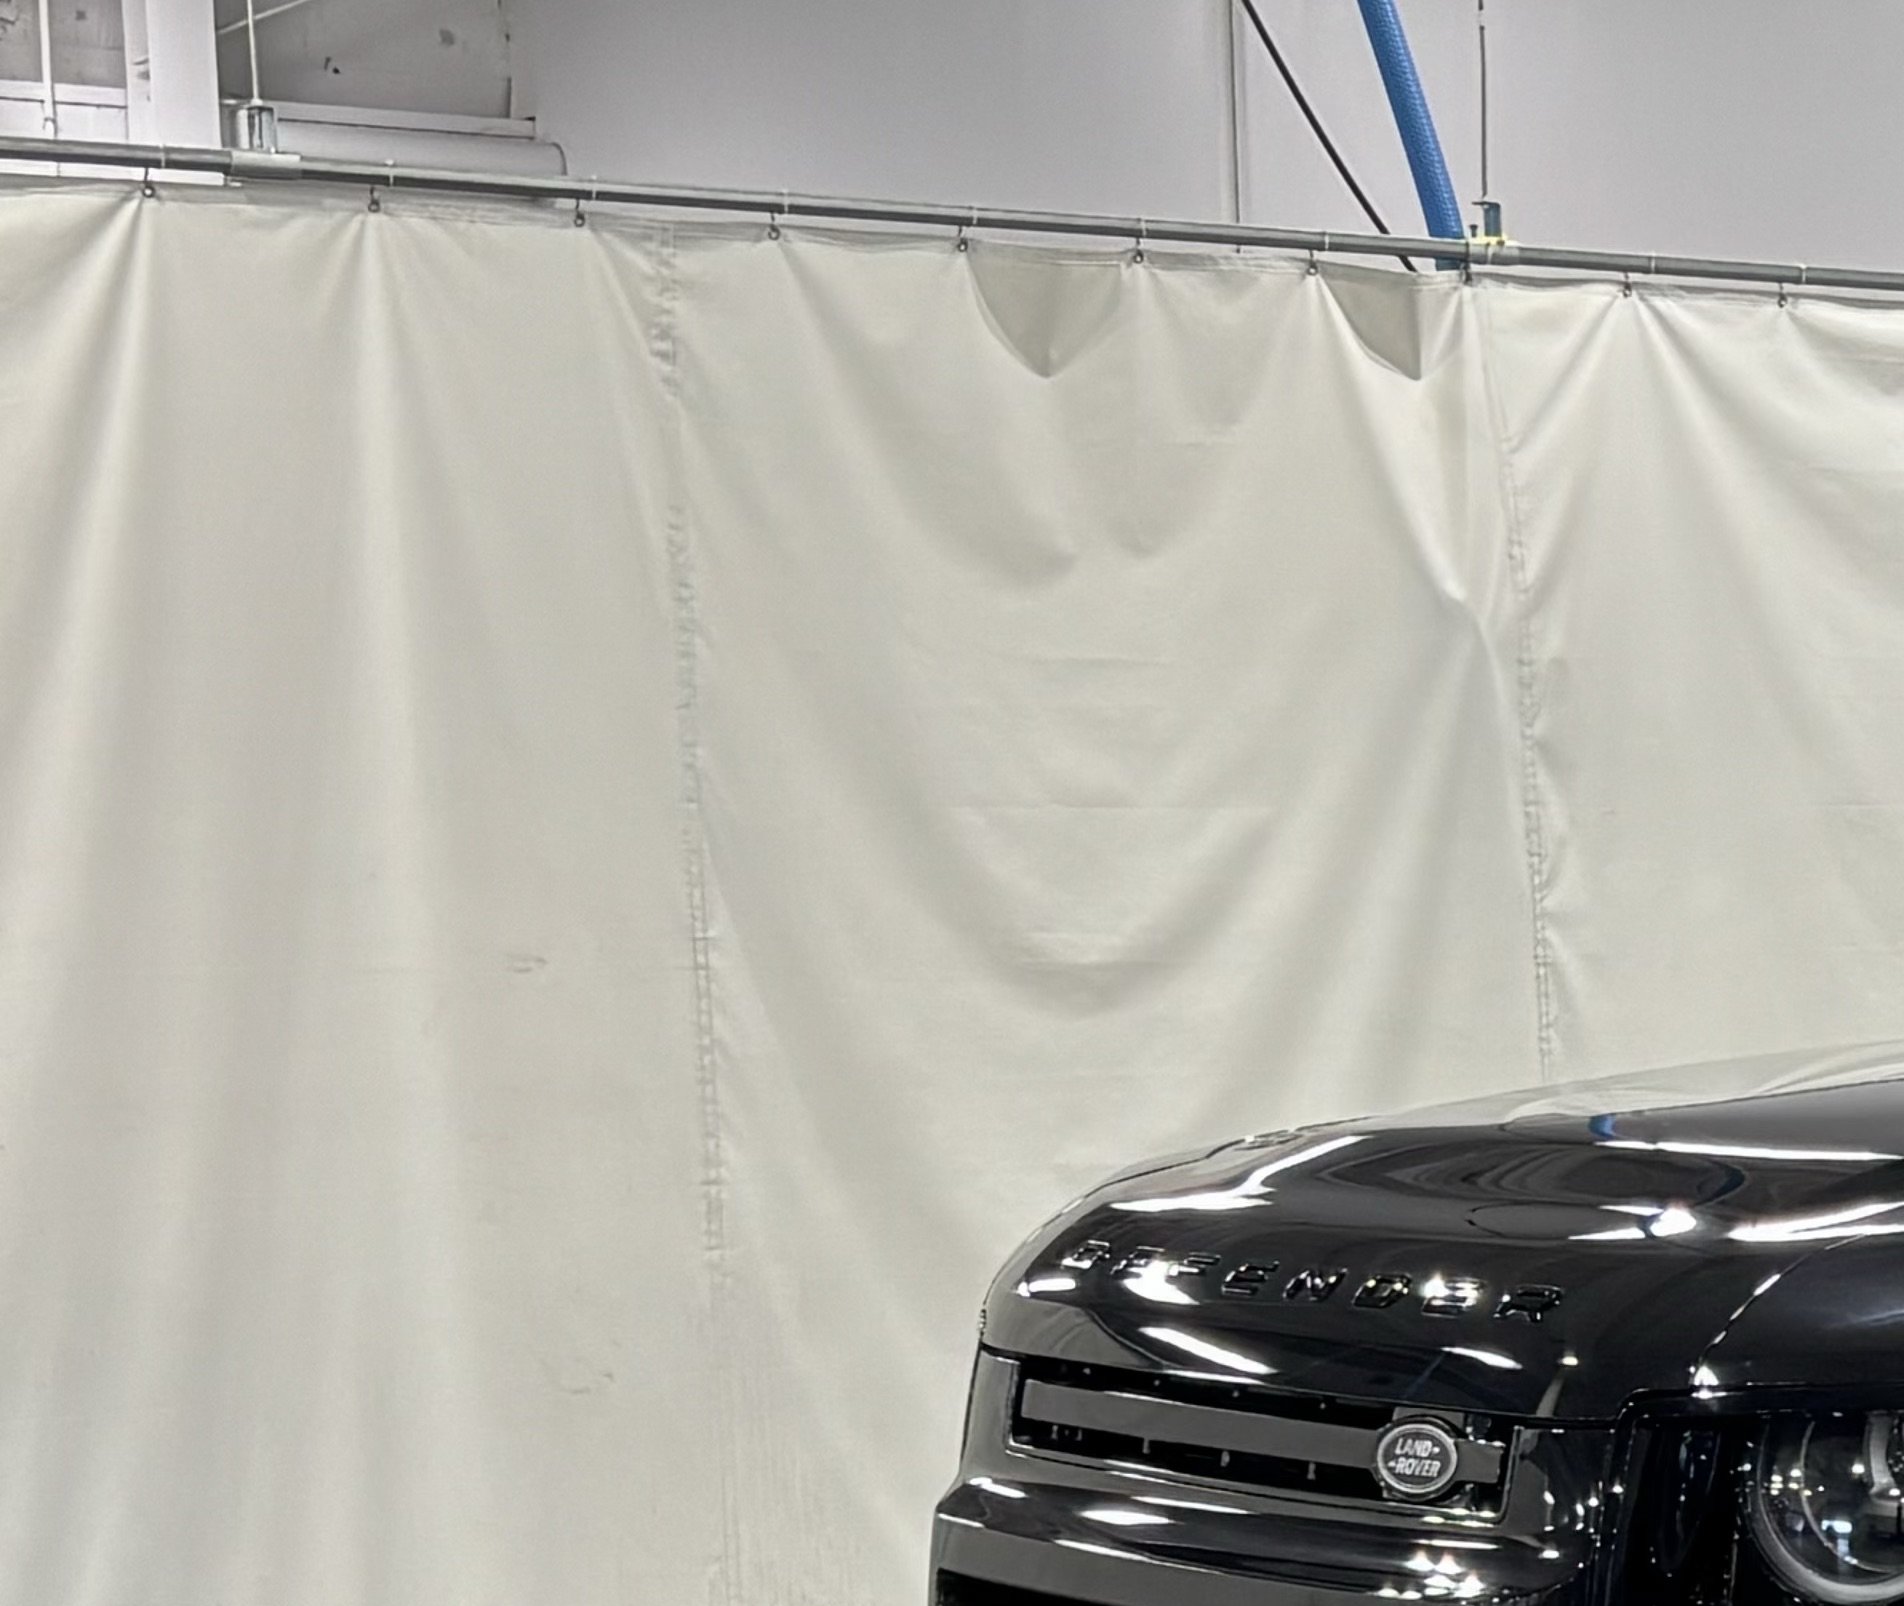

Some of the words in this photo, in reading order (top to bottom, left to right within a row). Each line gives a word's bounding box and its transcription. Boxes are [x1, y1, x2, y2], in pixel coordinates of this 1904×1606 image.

[1060, 1238, 1564, 1323] DEFENDER
[1394, 1437, 1433, 1458] LAND
[1394, 1456, 1441, 1478] ROVER
